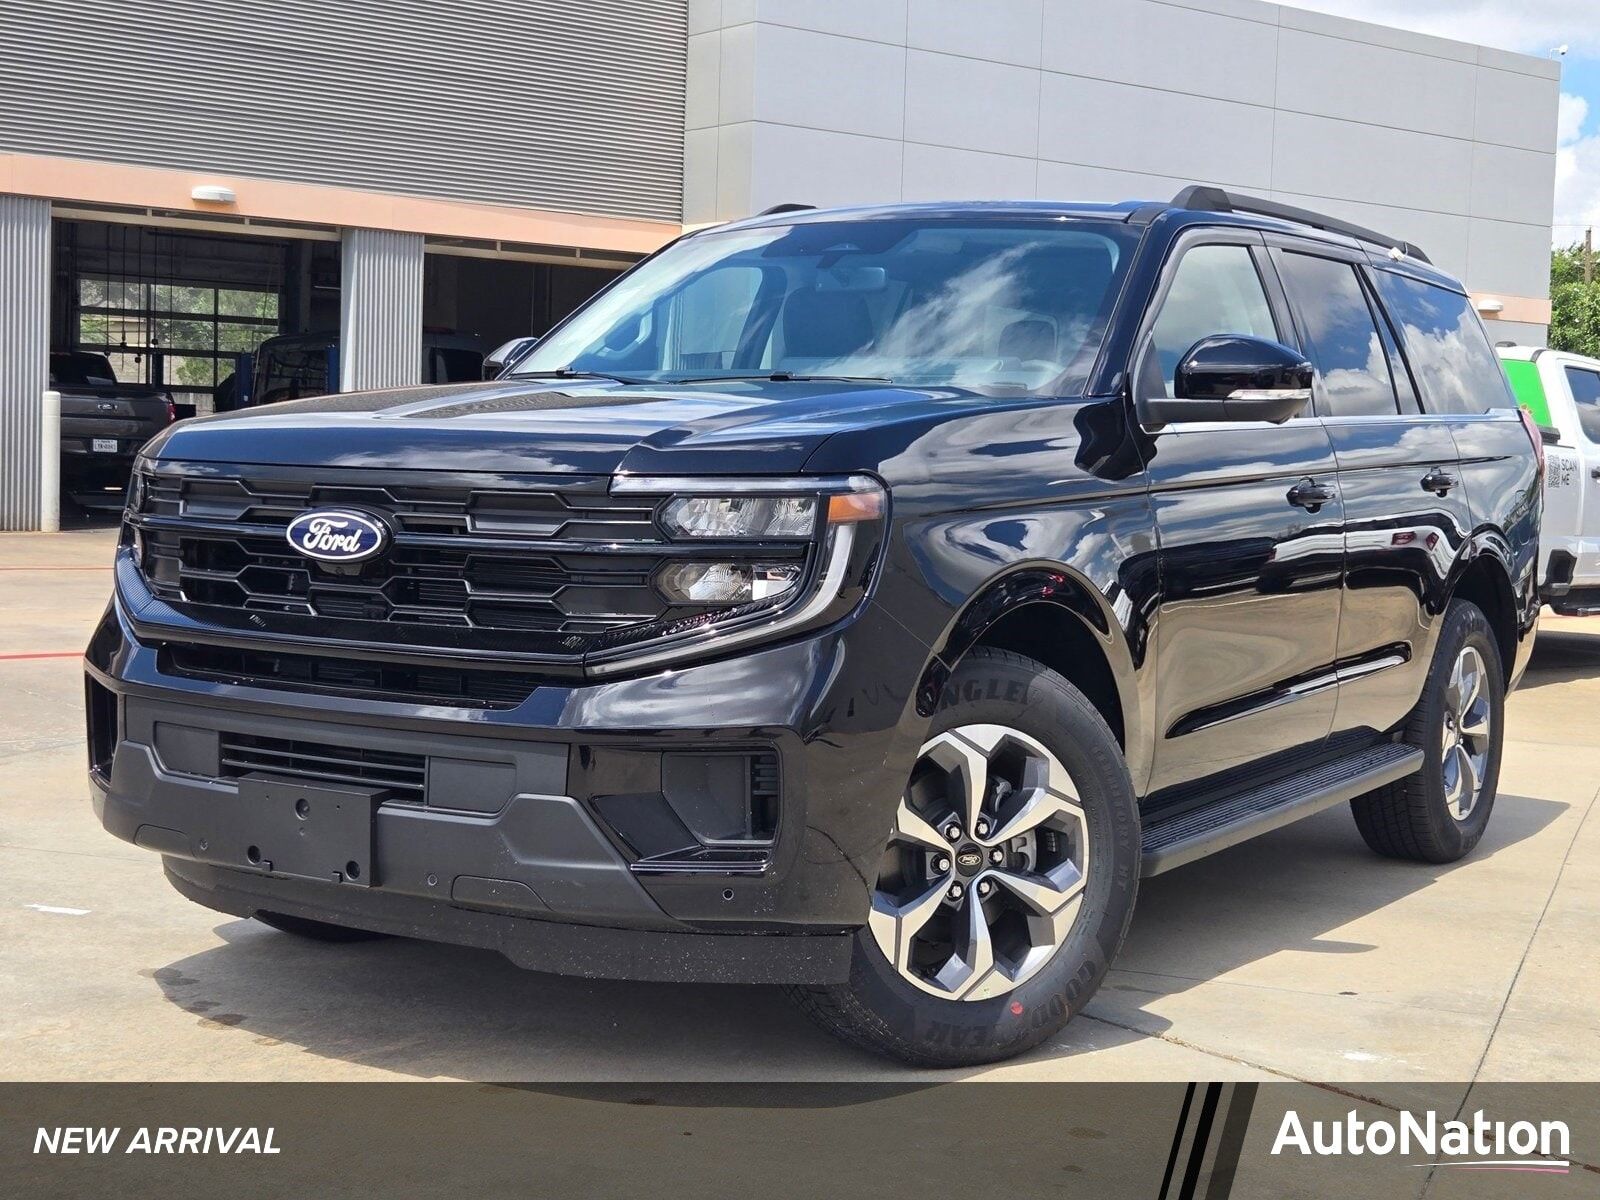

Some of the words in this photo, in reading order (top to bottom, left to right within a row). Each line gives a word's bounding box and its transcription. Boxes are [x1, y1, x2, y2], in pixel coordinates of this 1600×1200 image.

[1561, 459, 1577, 471] SCAN
[1561, 473, 1570, 486] ME
[302, 518, 363, 552] Ford
